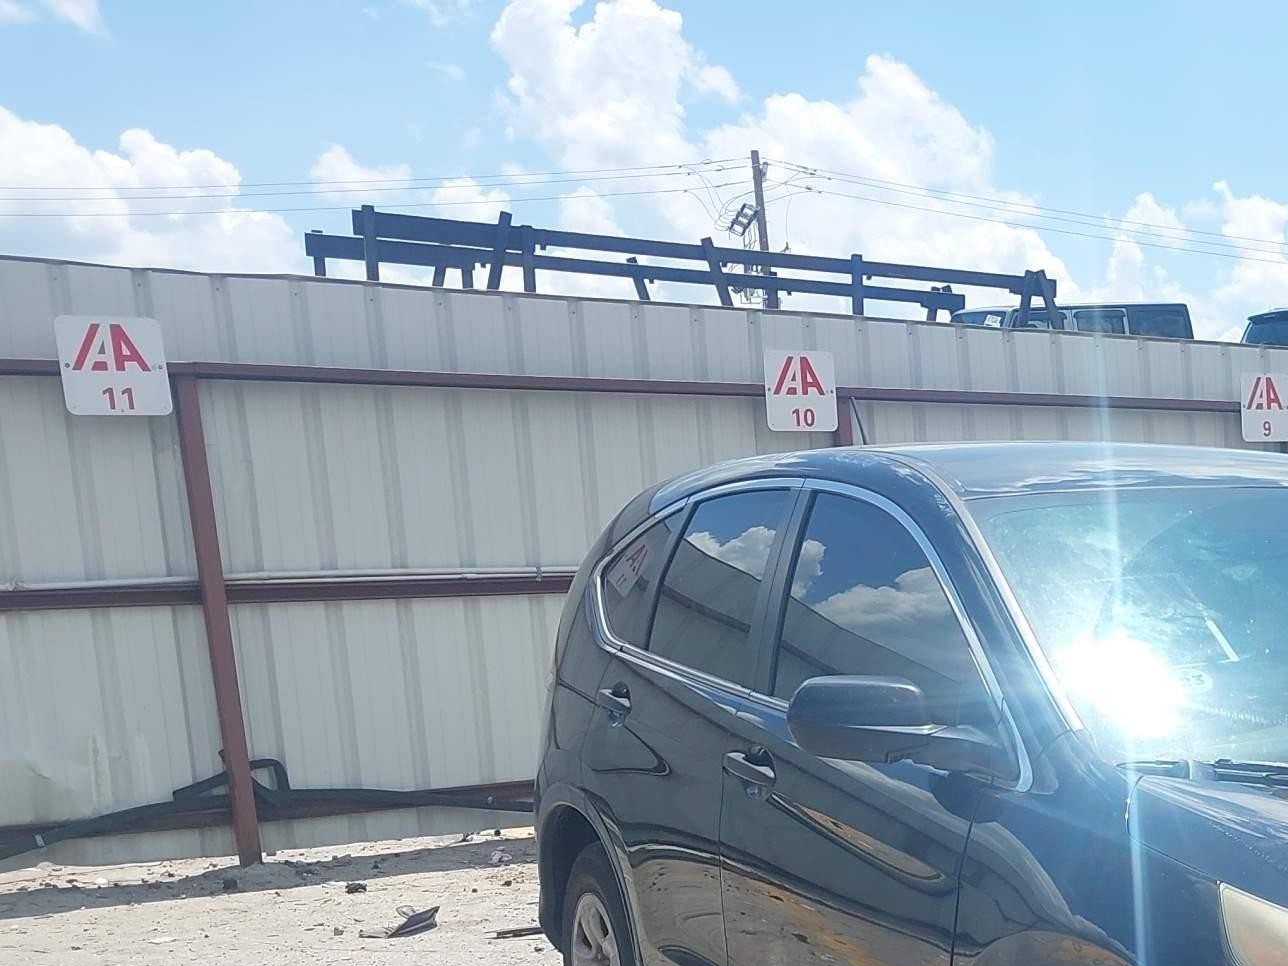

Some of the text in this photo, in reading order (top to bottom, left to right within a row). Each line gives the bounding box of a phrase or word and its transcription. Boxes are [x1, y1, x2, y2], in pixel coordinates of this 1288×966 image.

[102, 387, 134, 410] 11
[792, 408, 815, 427] 10
[1263, 421, 1271, 437] 9
